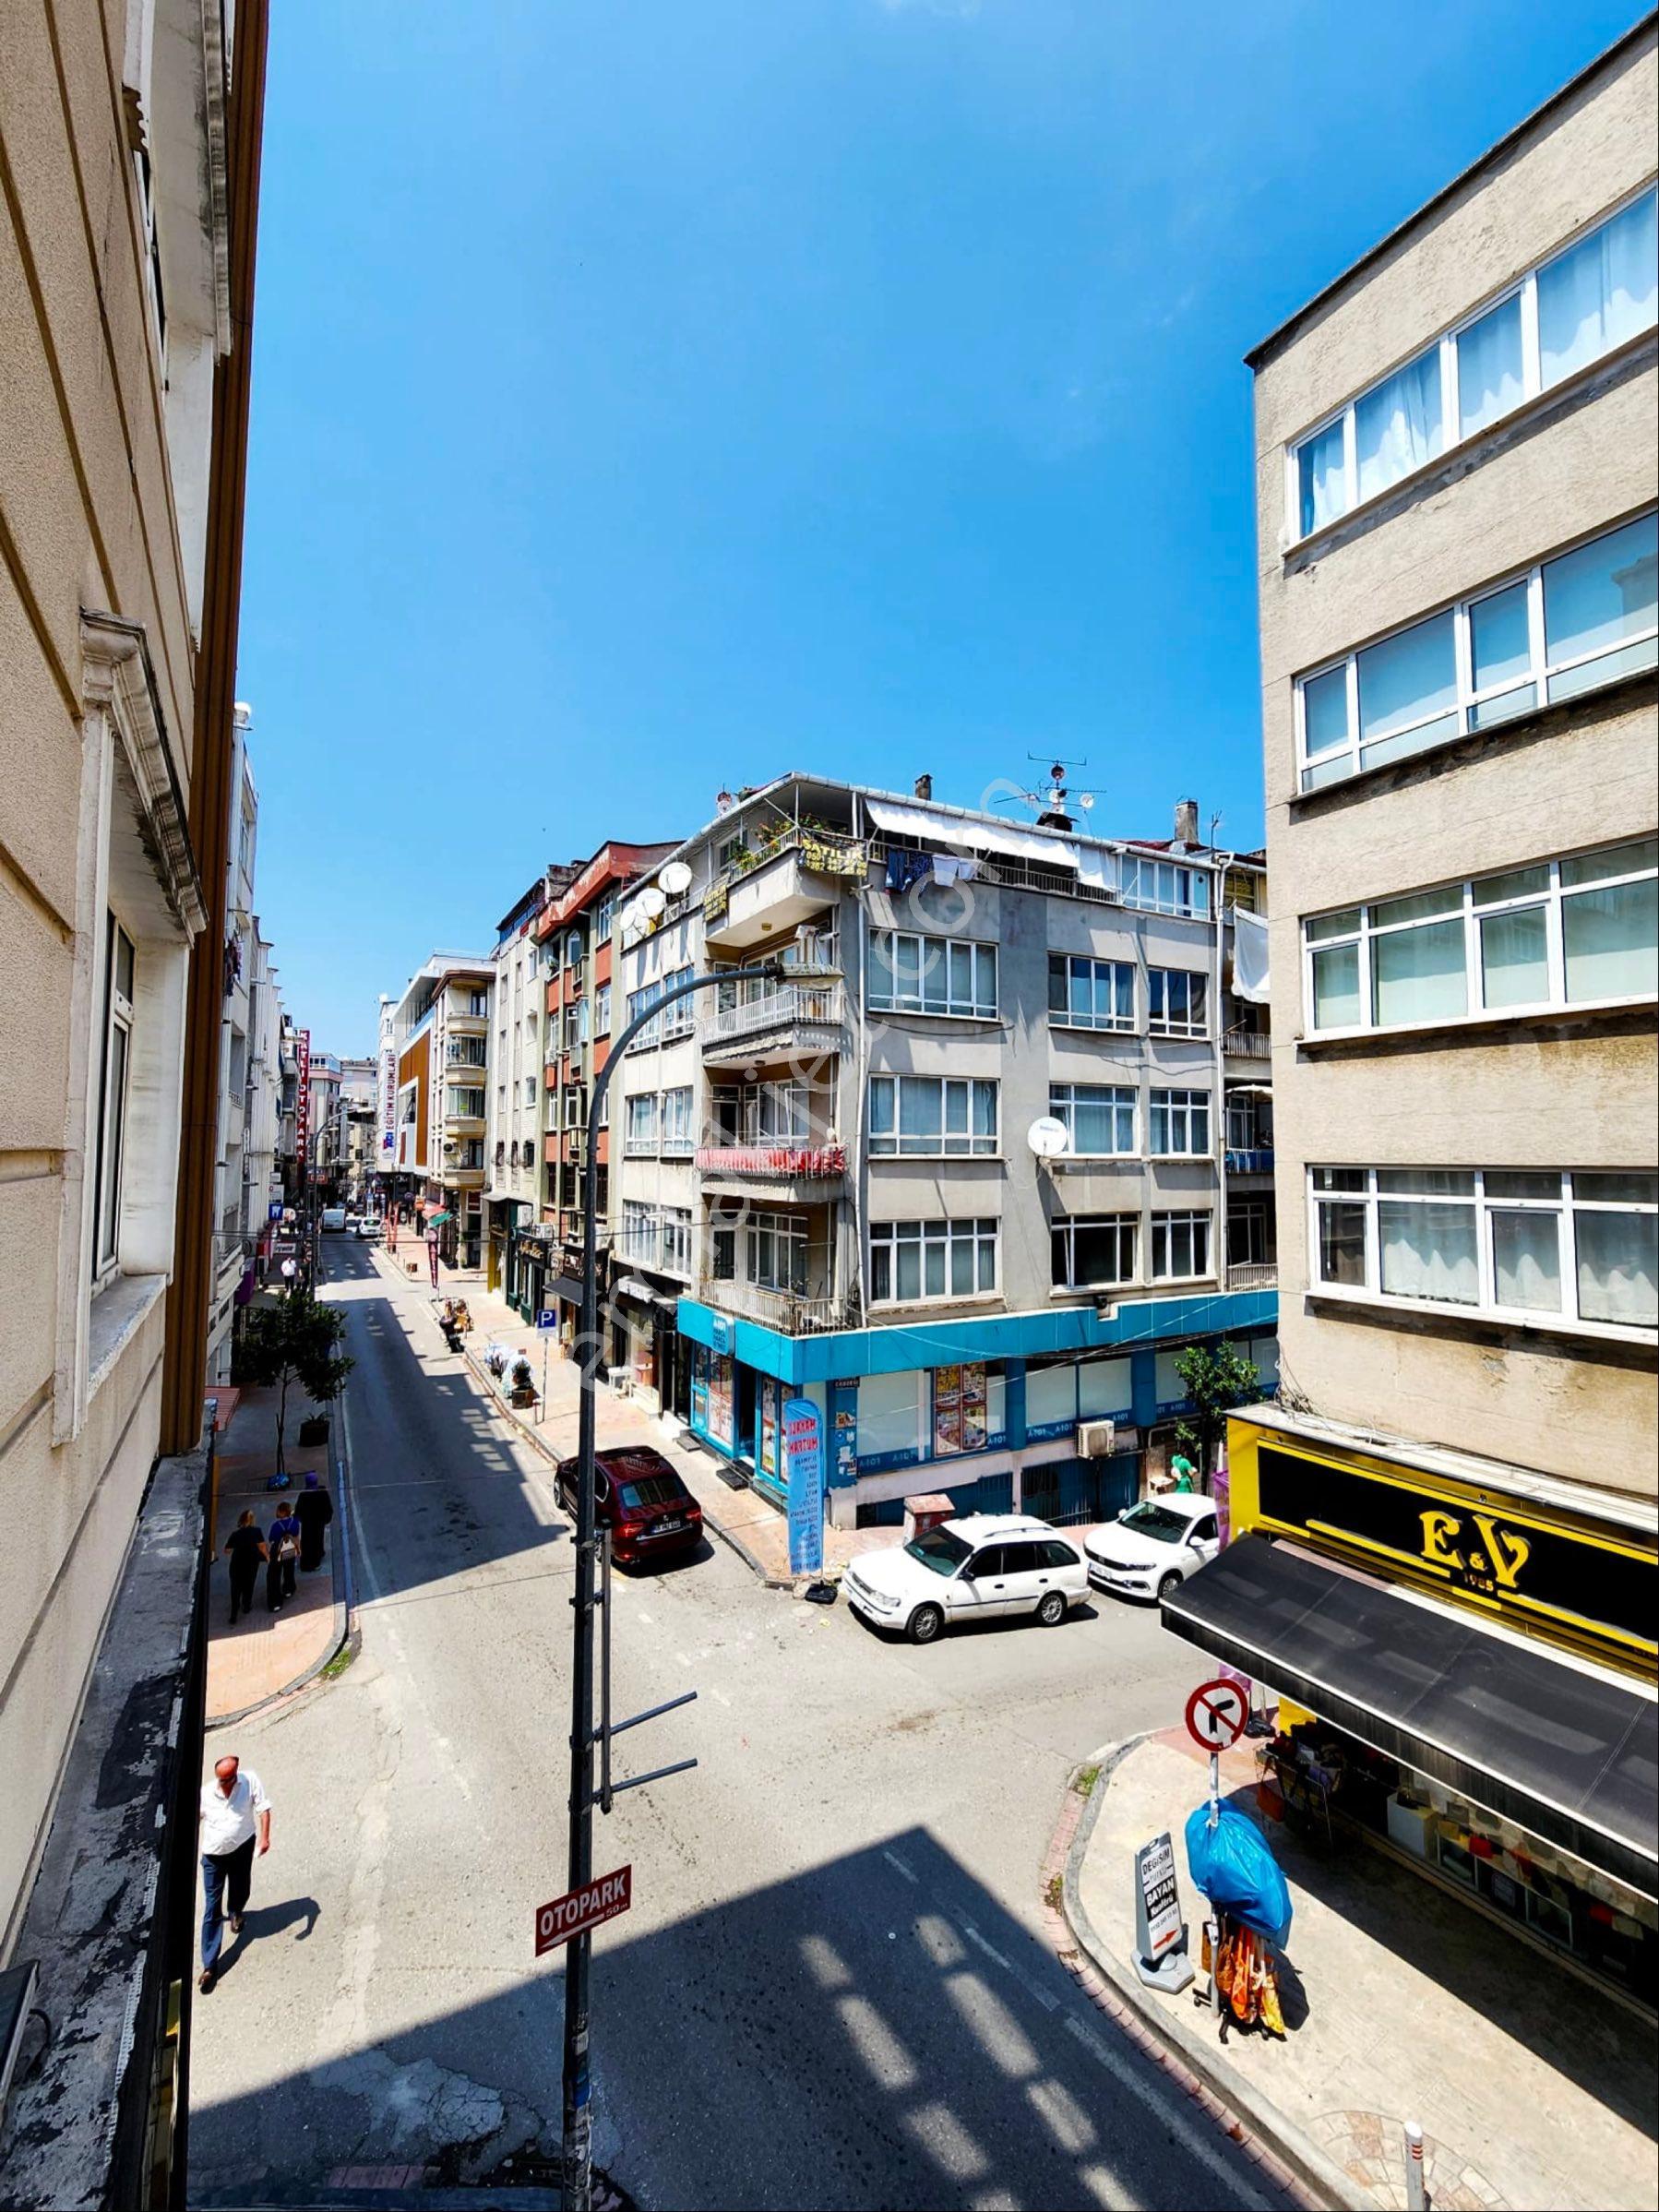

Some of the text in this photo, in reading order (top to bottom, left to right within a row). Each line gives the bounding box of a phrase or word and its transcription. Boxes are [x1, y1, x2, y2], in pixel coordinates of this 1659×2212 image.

[802, 838, 865, 861] SATILIK
[299, 1032, 308, 1077] KATLI
[296, 1084, 307, 1157] OTOPARK
[541, 1311, 553, 1326] P
[1112, 1413, 1128, 1422] A101
[1027, 1423, 1073, 1438] A101 A101
[988, 1436, 1007, 1446] A101
[860, 1457, 880, 1468] A101
[1419, 1511, 1531, 1588] E & V
[1146, 1879, 1175, 1907] BAYAN
[541, 1873, 626, 1936] OTOPARK
[606, 1905, 620, 1917] 50
